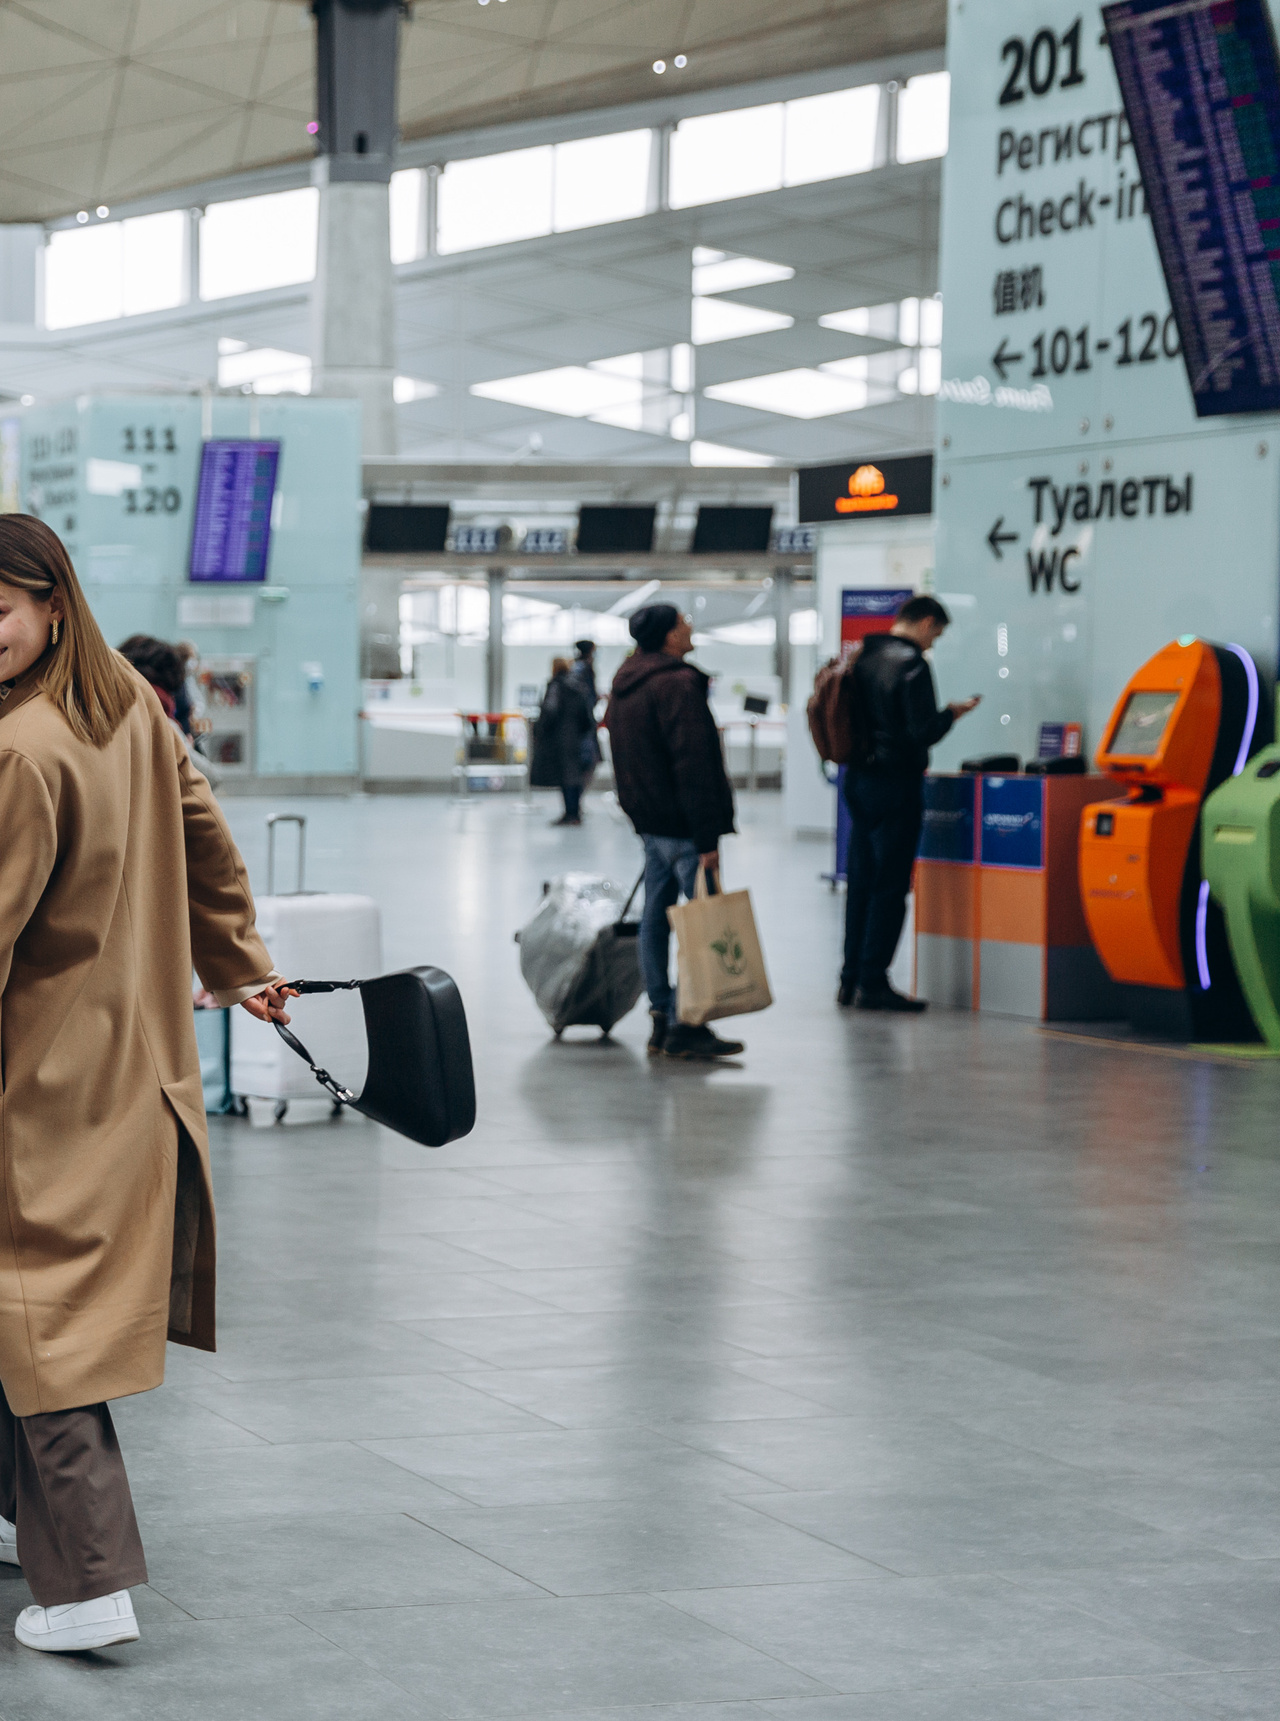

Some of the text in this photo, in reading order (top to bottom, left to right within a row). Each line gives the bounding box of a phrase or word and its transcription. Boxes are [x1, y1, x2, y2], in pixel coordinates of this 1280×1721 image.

[999, 17, 1085, 107] 201
[994, 171, 1150, 246] Check-in
[994, 265, 1045, 316] 值机
[123, 427, 177, 454] 111
[125, 484, 182, 515] 120
[1028, 472, 1195, 537] Туалеты
[1026, 547, 1082, 595] WC
